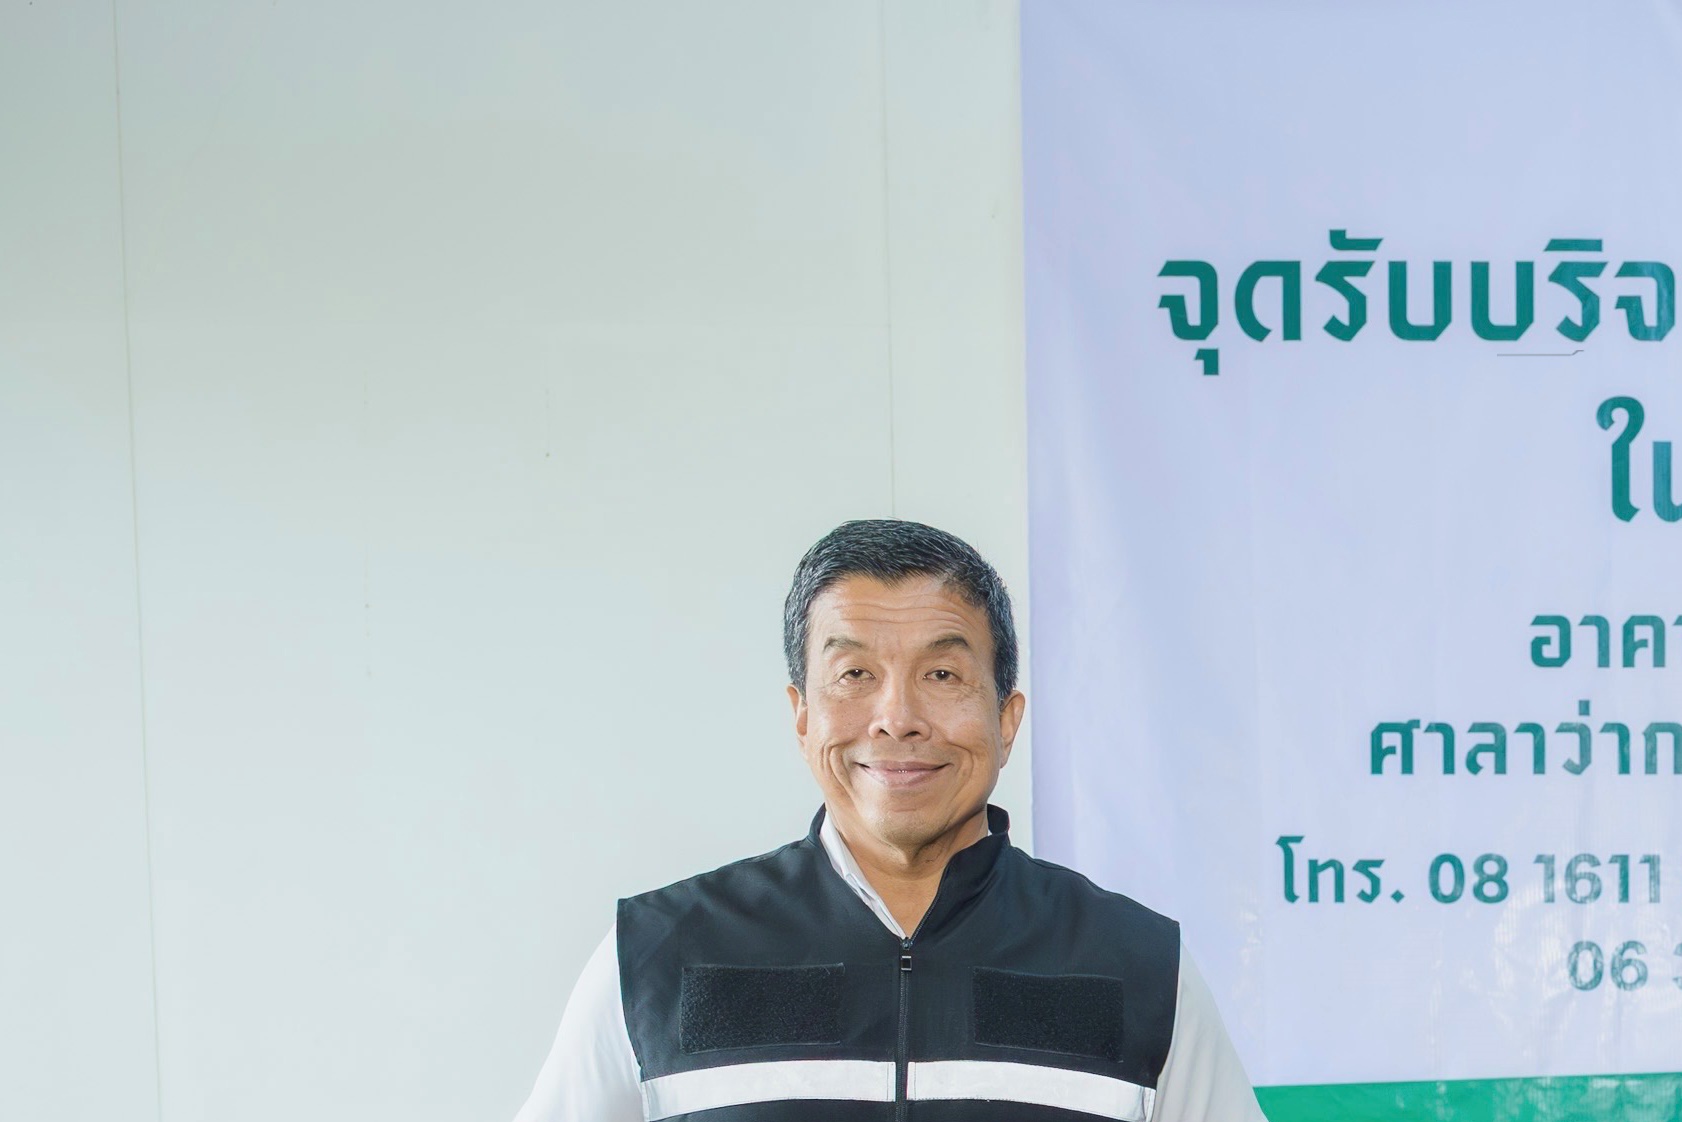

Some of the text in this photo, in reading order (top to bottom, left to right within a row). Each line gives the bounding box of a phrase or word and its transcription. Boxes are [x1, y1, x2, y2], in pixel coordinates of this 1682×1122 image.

[1275, 834, 1405, 904] โทร.
[1428, 852, 1511, 904] 08
[1532, 853, 1661, 905] 1611
[1566, 938, 1649, 992] 06
